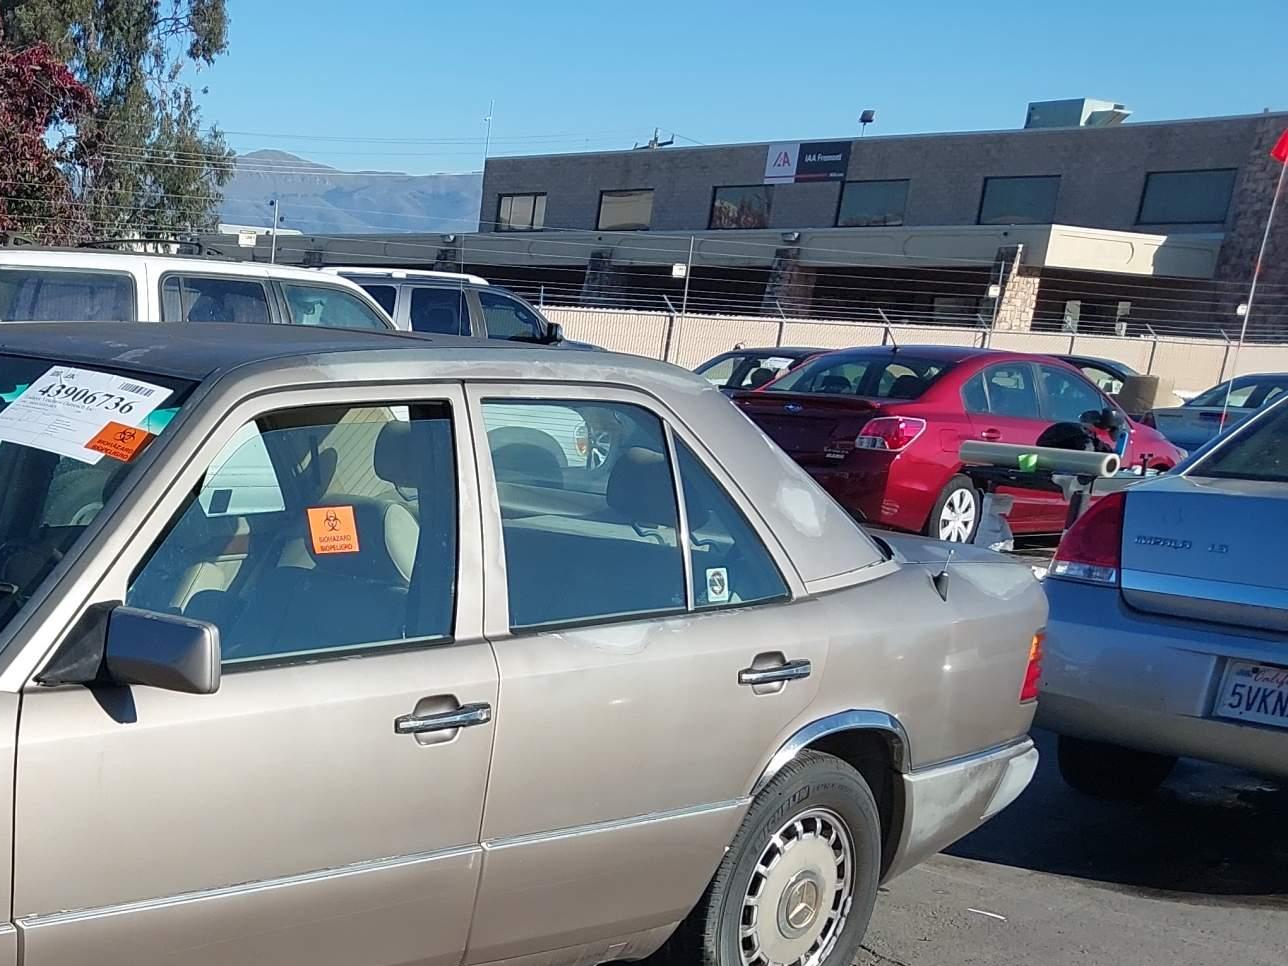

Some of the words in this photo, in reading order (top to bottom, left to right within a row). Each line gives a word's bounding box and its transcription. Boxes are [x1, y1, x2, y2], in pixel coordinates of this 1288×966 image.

[38, 383, 140, 414] 43906736
[319, 535, 352, 543] BIOHAZARD
[1134, 535, 1192, 550] IMPALA
[320, 543, 353, 552] BIOPELIGRO
[1228, 682, 1288, 718] 5VKN
